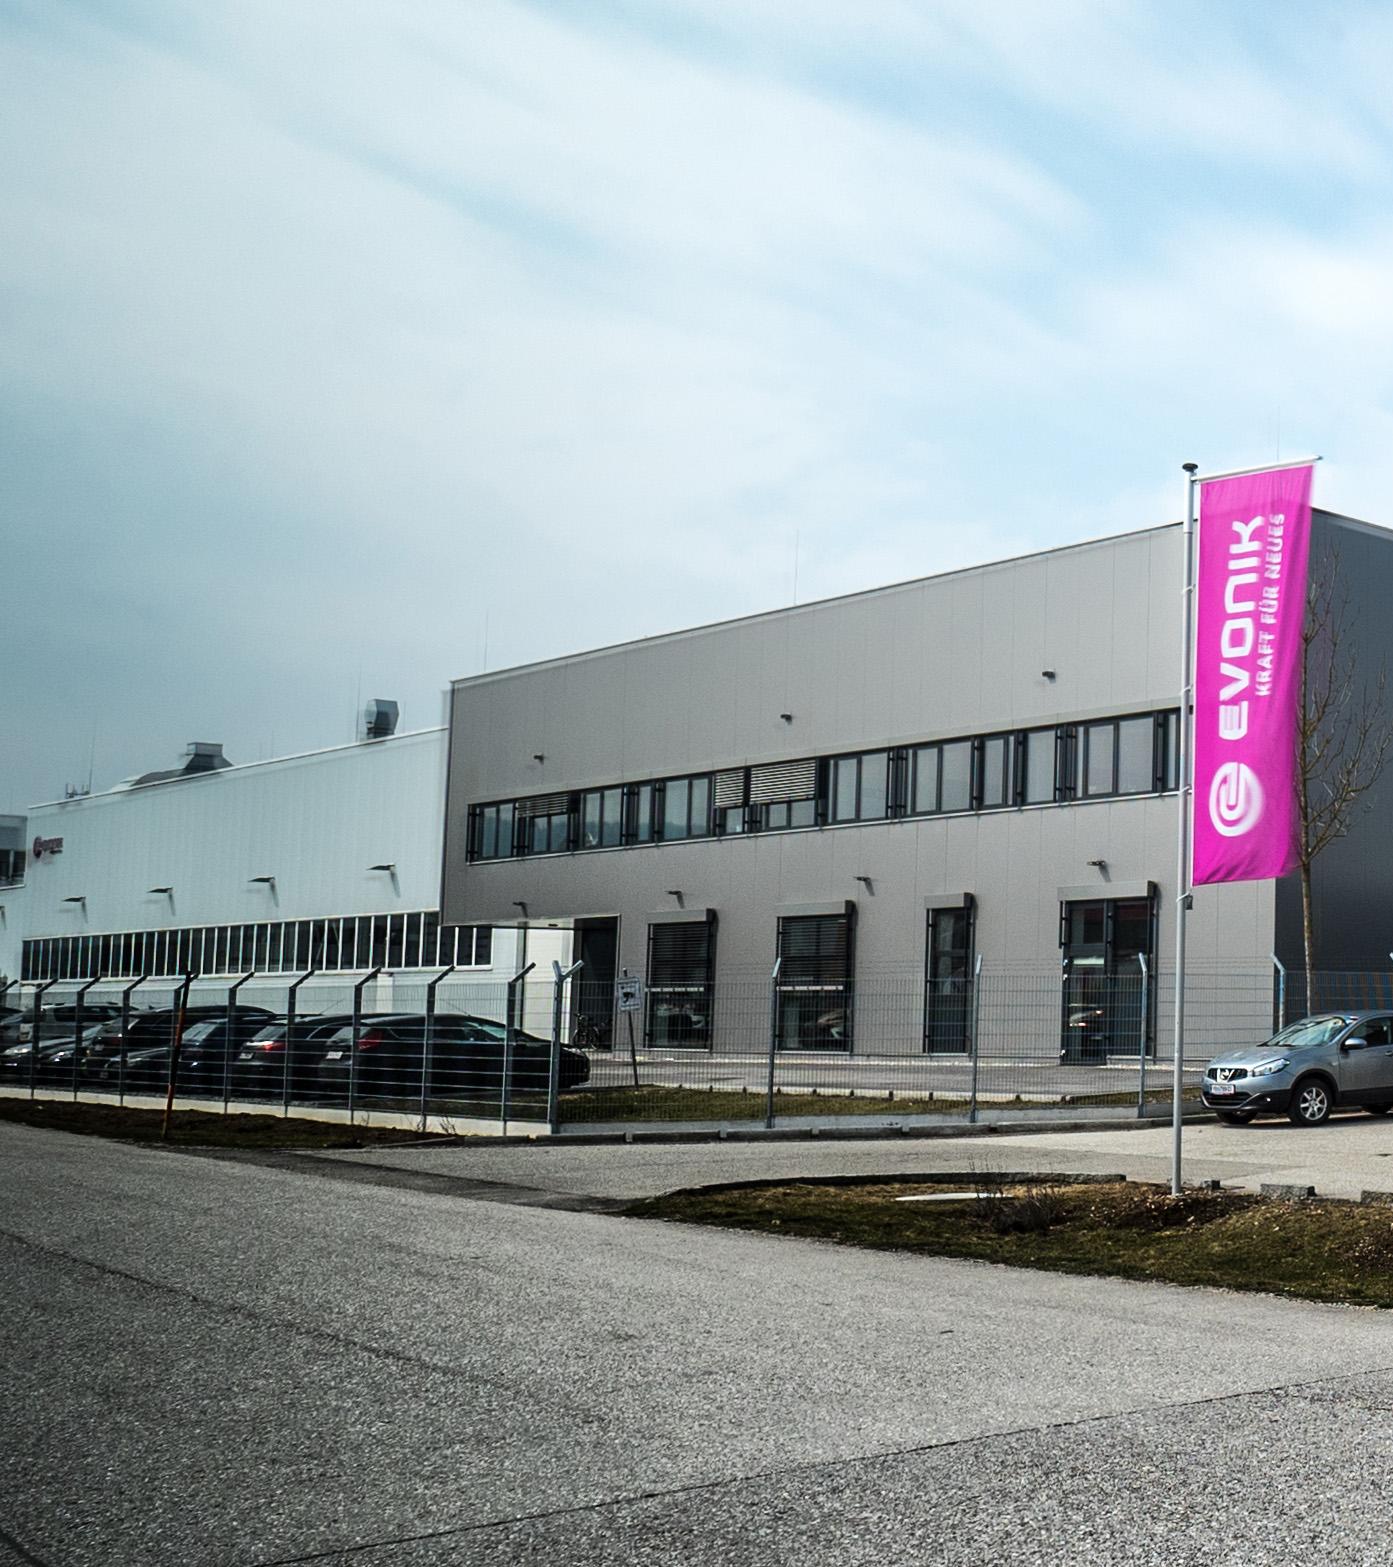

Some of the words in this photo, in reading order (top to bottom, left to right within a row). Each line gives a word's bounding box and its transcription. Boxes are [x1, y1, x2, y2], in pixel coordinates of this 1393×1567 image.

[1264, 513, 1285, 580] NEUES
[1218, 515, 1264, 740] EVONIK
[1259, 585, 1280, 625] FÜR
[1255, 630, 1275, 697] KRAFT
